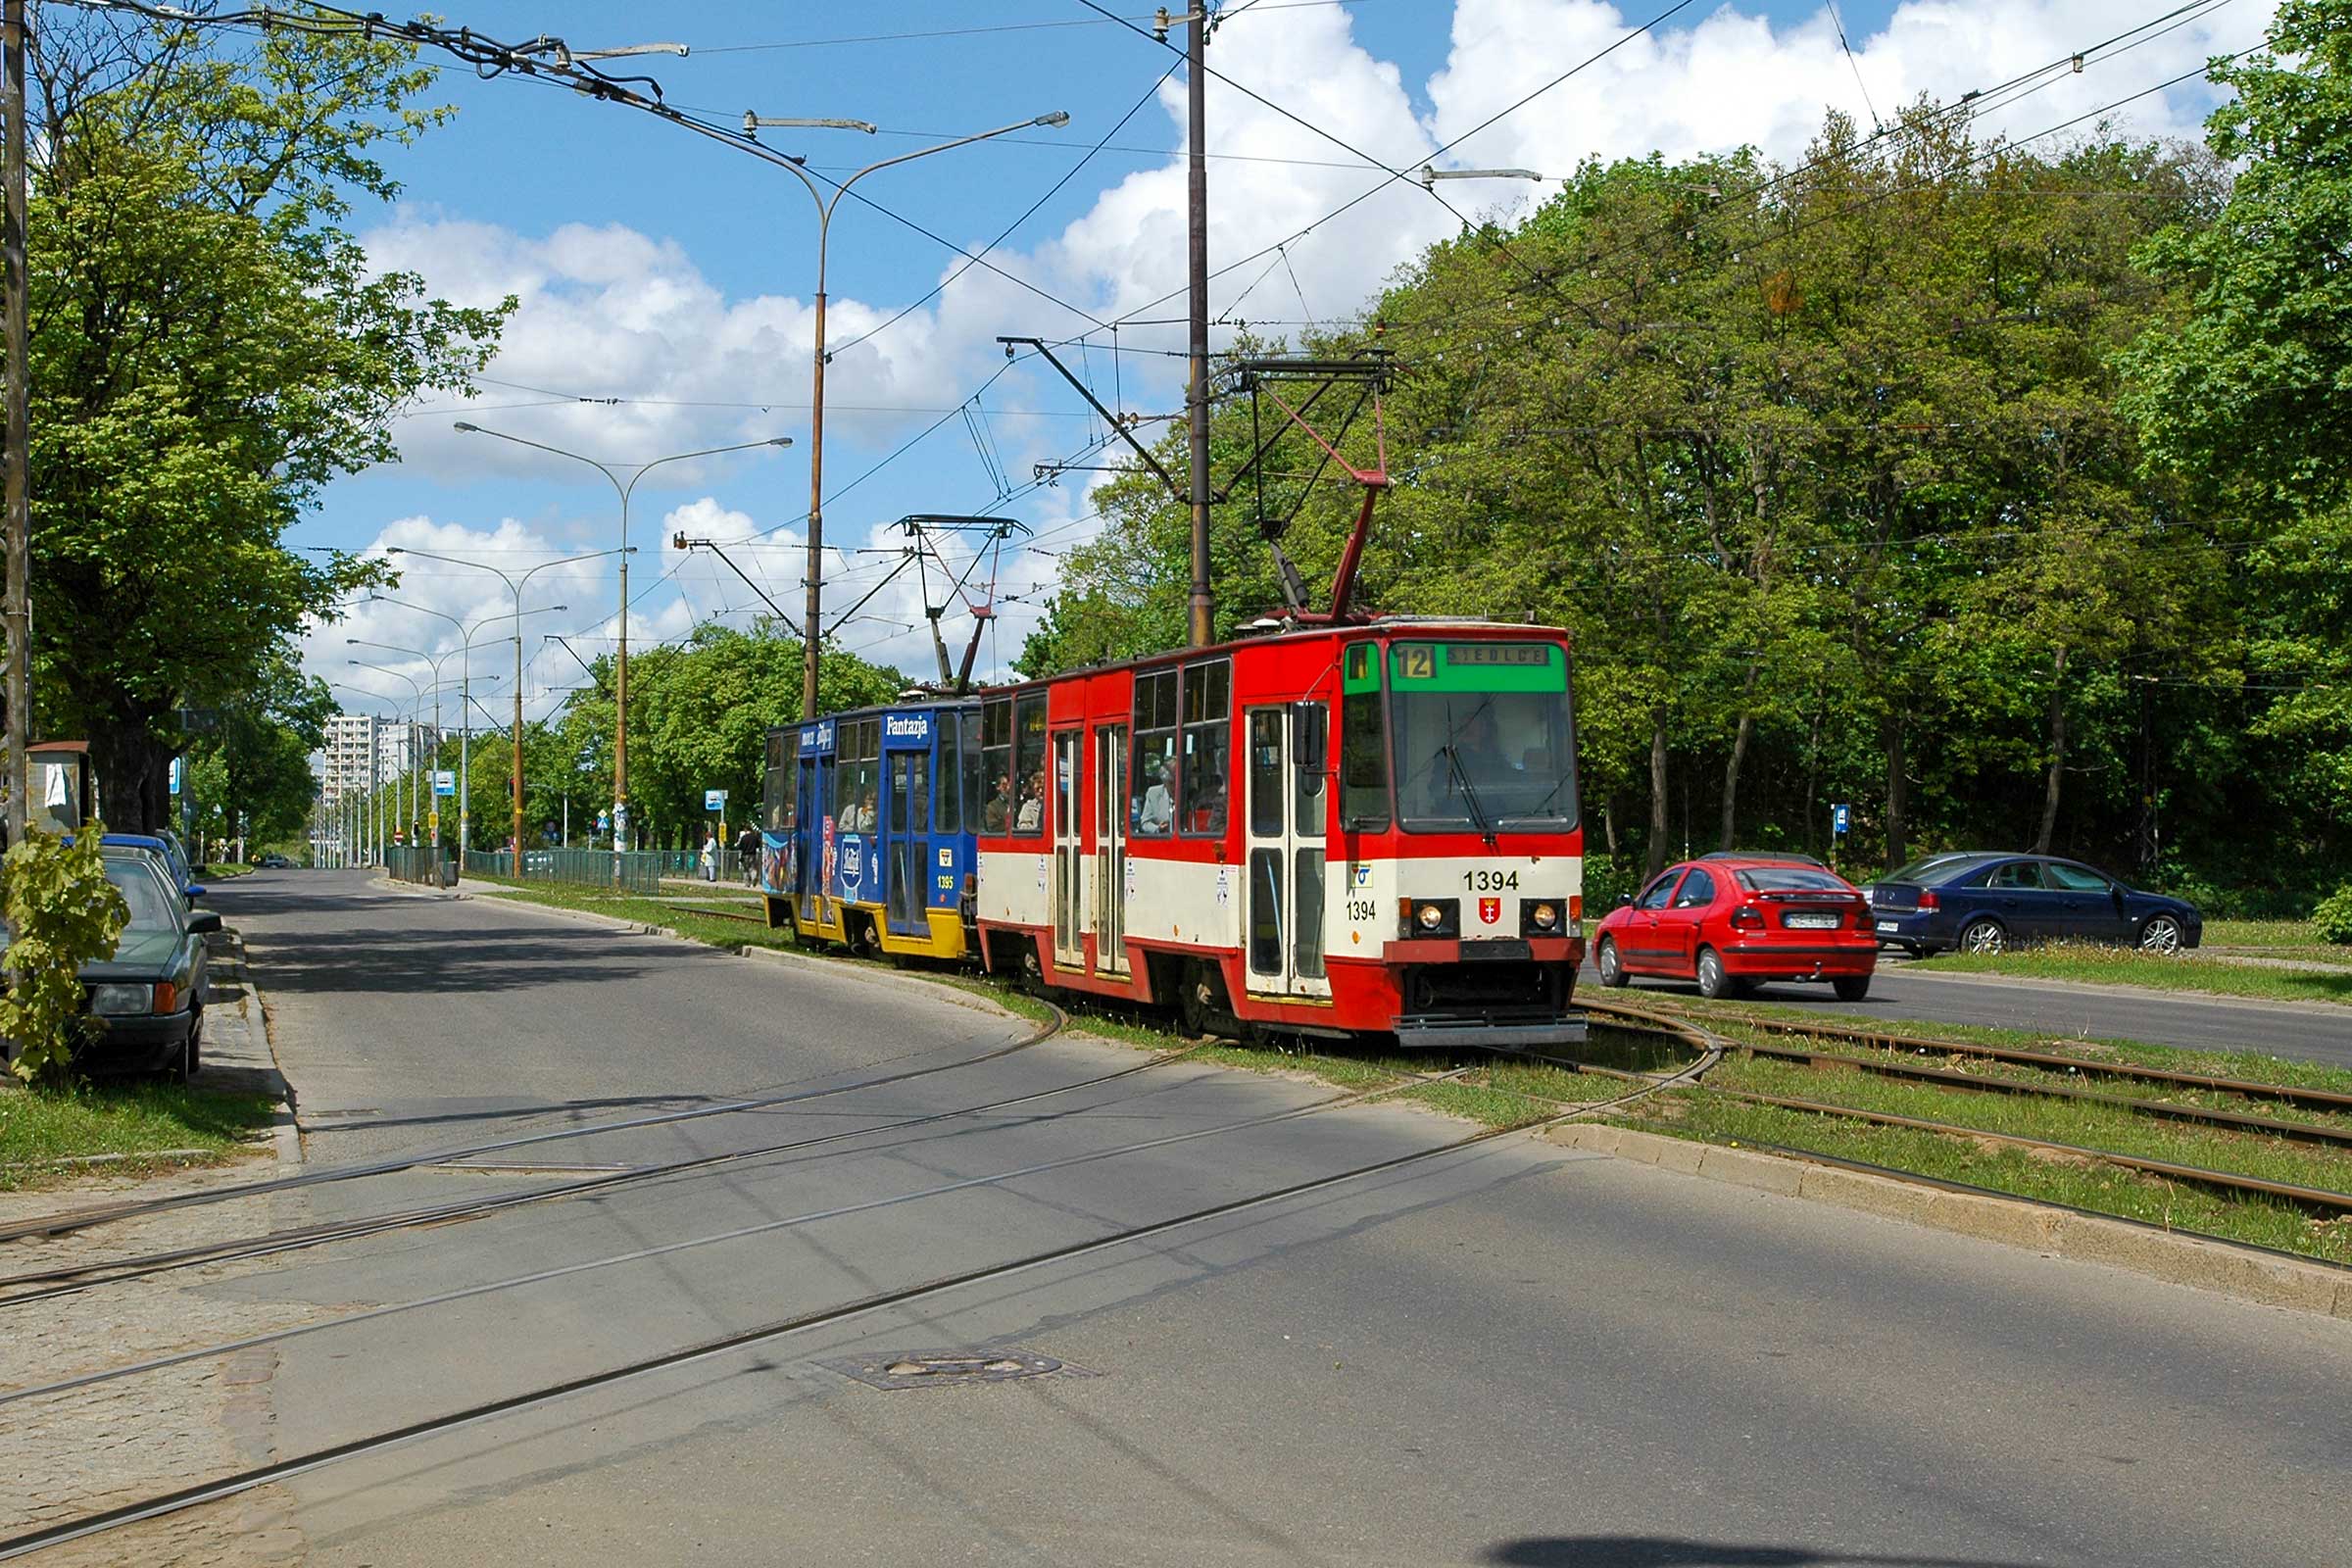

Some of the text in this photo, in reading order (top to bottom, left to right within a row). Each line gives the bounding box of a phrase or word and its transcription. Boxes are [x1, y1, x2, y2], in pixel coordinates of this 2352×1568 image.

[1400, 648, 1542, 675] 12 SIEDLCE
[886, 714, 928, 740] Fantazja
[937, 874, 954, 890] 1395
[1463, 870, 1519, 891] 1394
[1346, 900, 1376, 921] 1394
